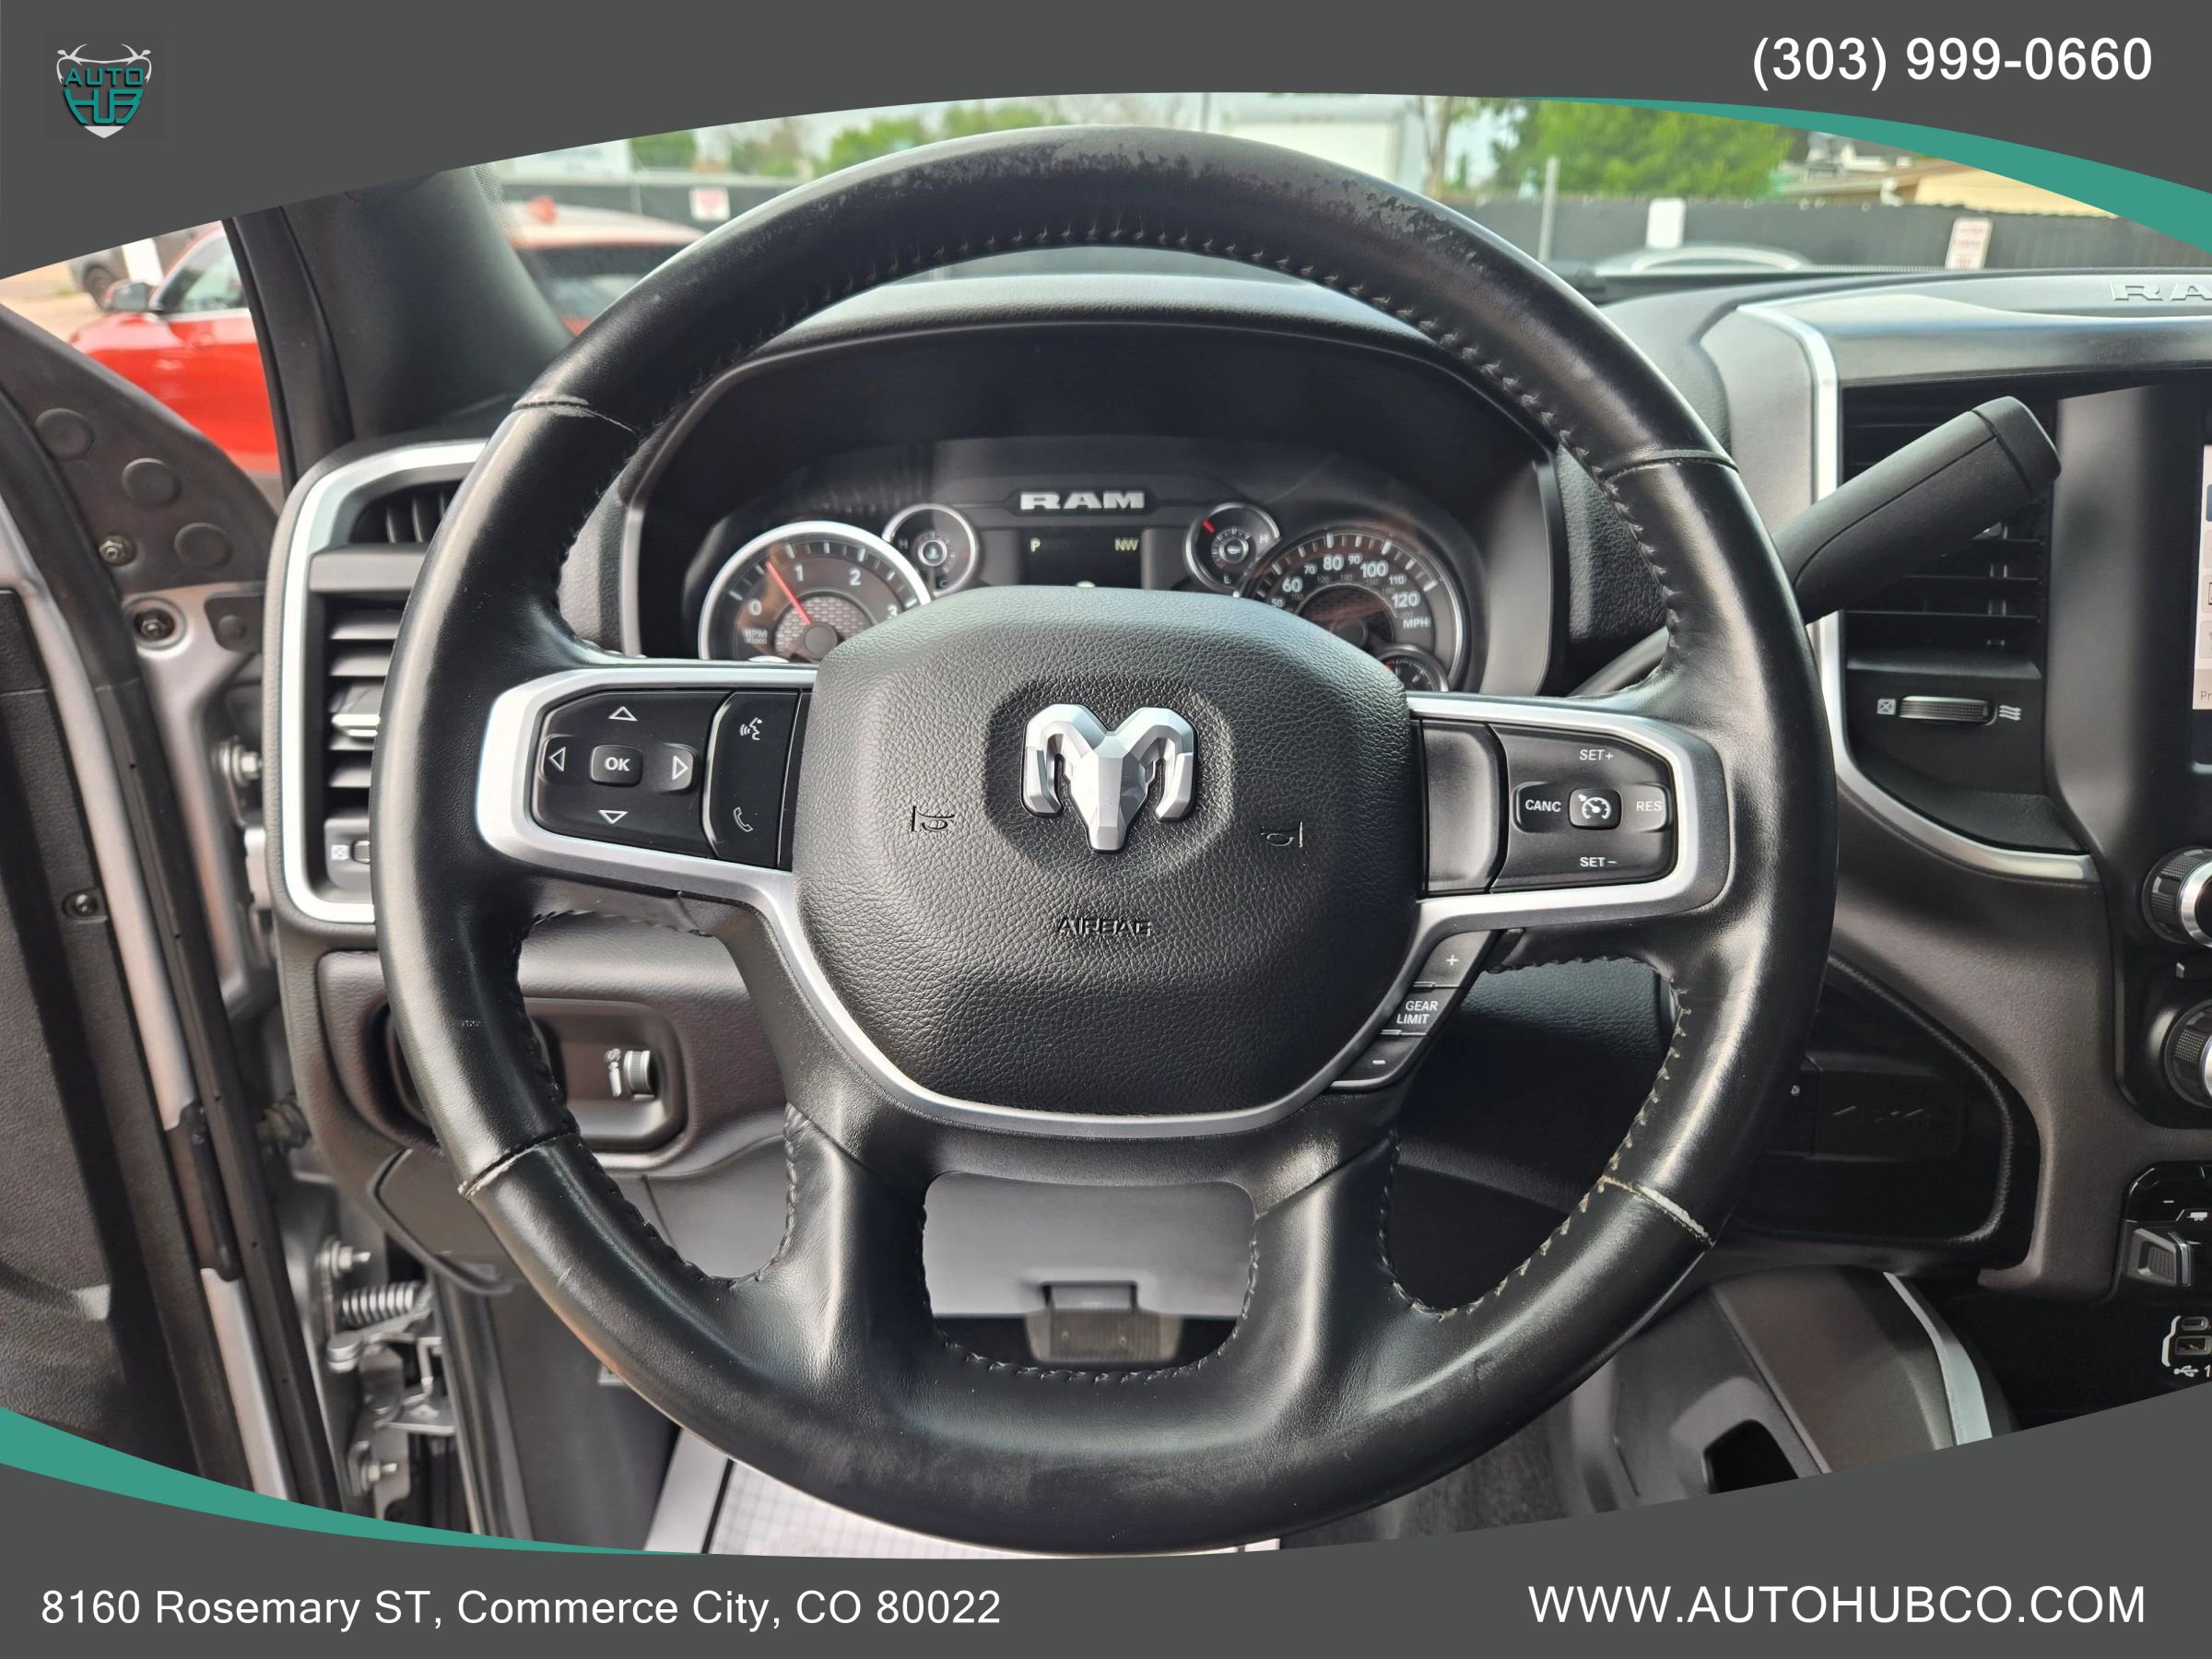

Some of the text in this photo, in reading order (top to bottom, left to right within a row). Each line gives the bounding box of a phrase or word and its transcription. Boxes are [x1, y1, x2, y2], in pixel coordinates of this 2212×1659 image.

[1020, 491, 1145, 510] RAM
[1030, 537, 1041, 552] P
[1114, 537, 1139, 551] NW
[1323, 556, 1344, 571] 80
[1348, 555, 1362, 564] 90
[795, 564, 804, 582] 1
[1303, 564, 1317, 575] 70
[1360, 562, 1388, 578] 100
[849, 570, 861, 585] 2
[1389, 574, 1406, 584] 110
[1282, 578, 1303, 593] 60
[1392, 591, 1420, 607] 120
[748, 599, 762, 616] 0
[887, 605, 898, 618] 3
[1403, 619, 1430, 629] MPH
[746, 629, 767, 638] RPM
[605, 757, 630, 771] OK
[1525, 799, 1561, 812] CANC
[1636, 801, 1663, 811] RES
[1058, 917, 1151, 936] AIRBAG
[1406, 1001, 1438, 1011] GEAR
[1396, 1014, 1430, 1025] LIMIT
[2204, 1364, 2211, 1377] 1
